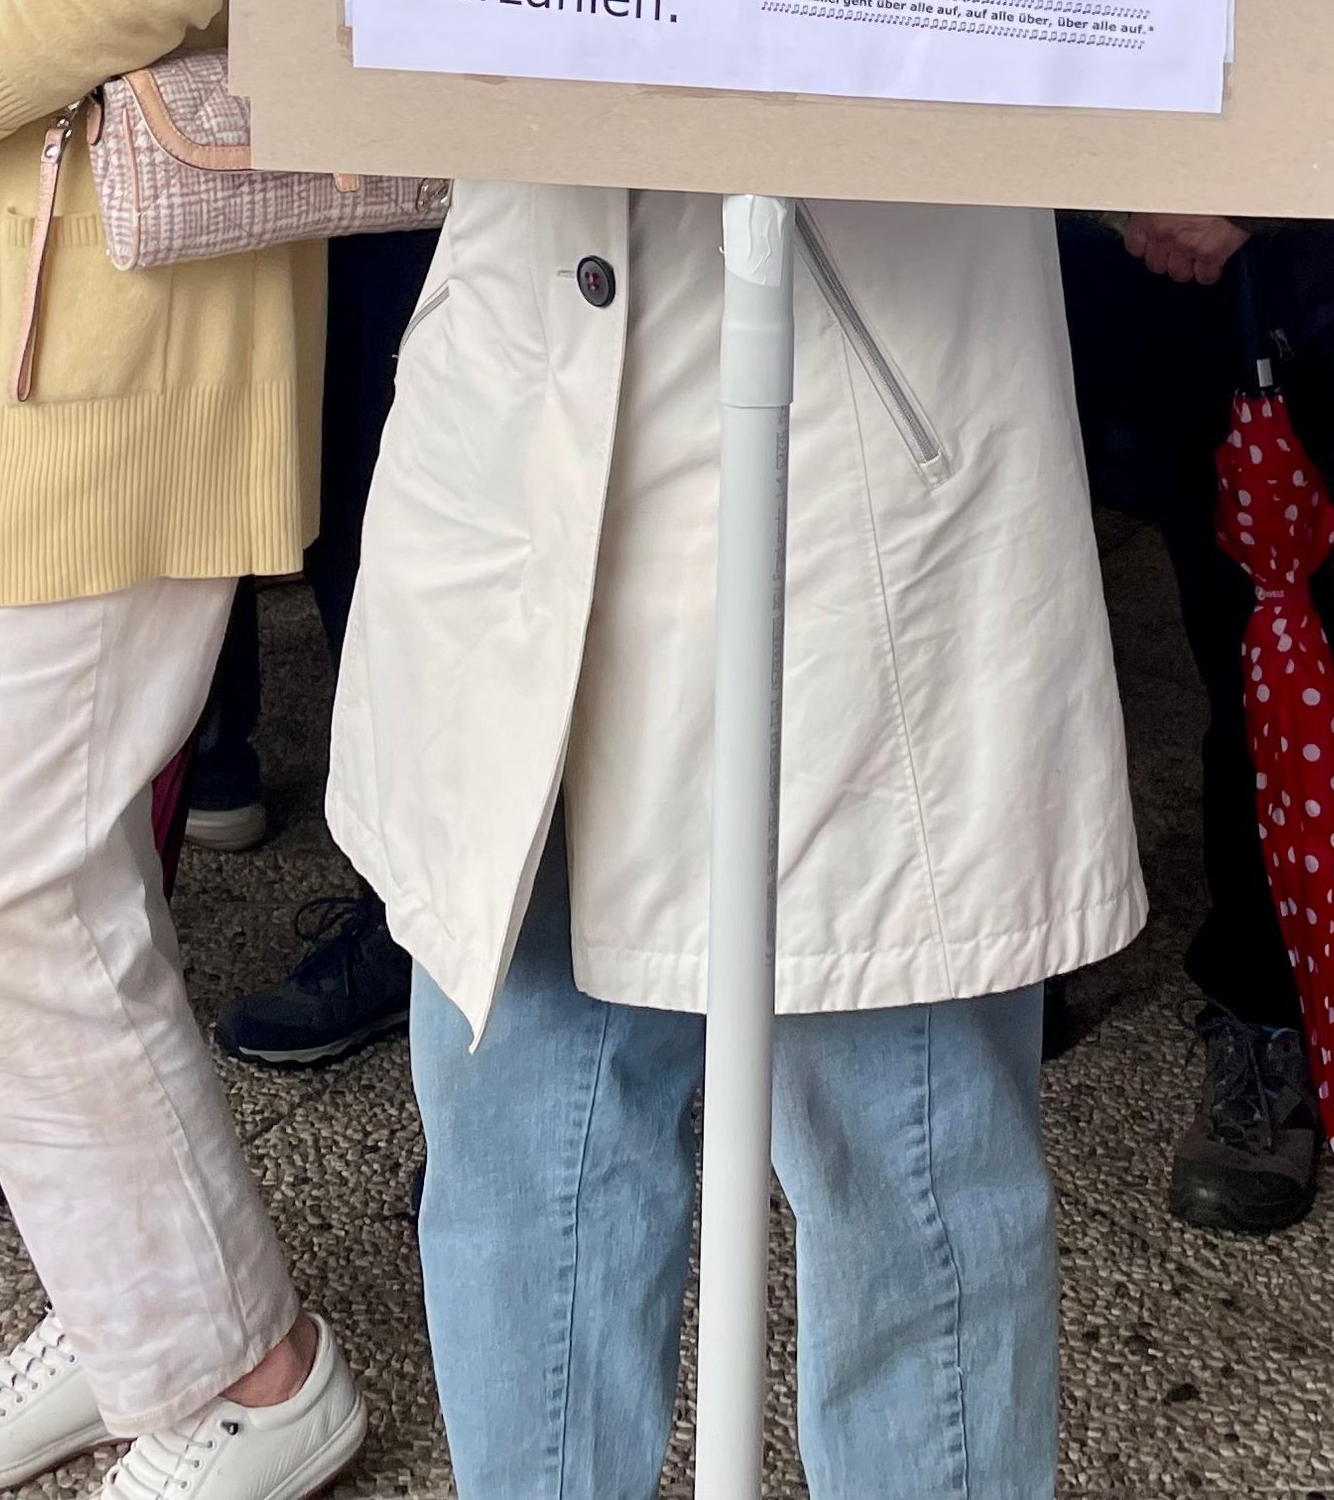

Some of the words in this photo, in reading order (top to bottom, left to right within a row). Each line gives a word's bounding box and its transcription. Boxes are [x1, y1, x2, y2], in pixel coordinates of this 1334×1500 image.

[910, 0, 934, 16] alle
[936, 4, 963, 19] auf,
[965, 7, 988, 21] auf
[990, 9, 1015, 24] alle
[1017, 12, 1053, 28] über,
[1057, 15, 1089, 30] über
[1091, 19, 1118, 34] alle
